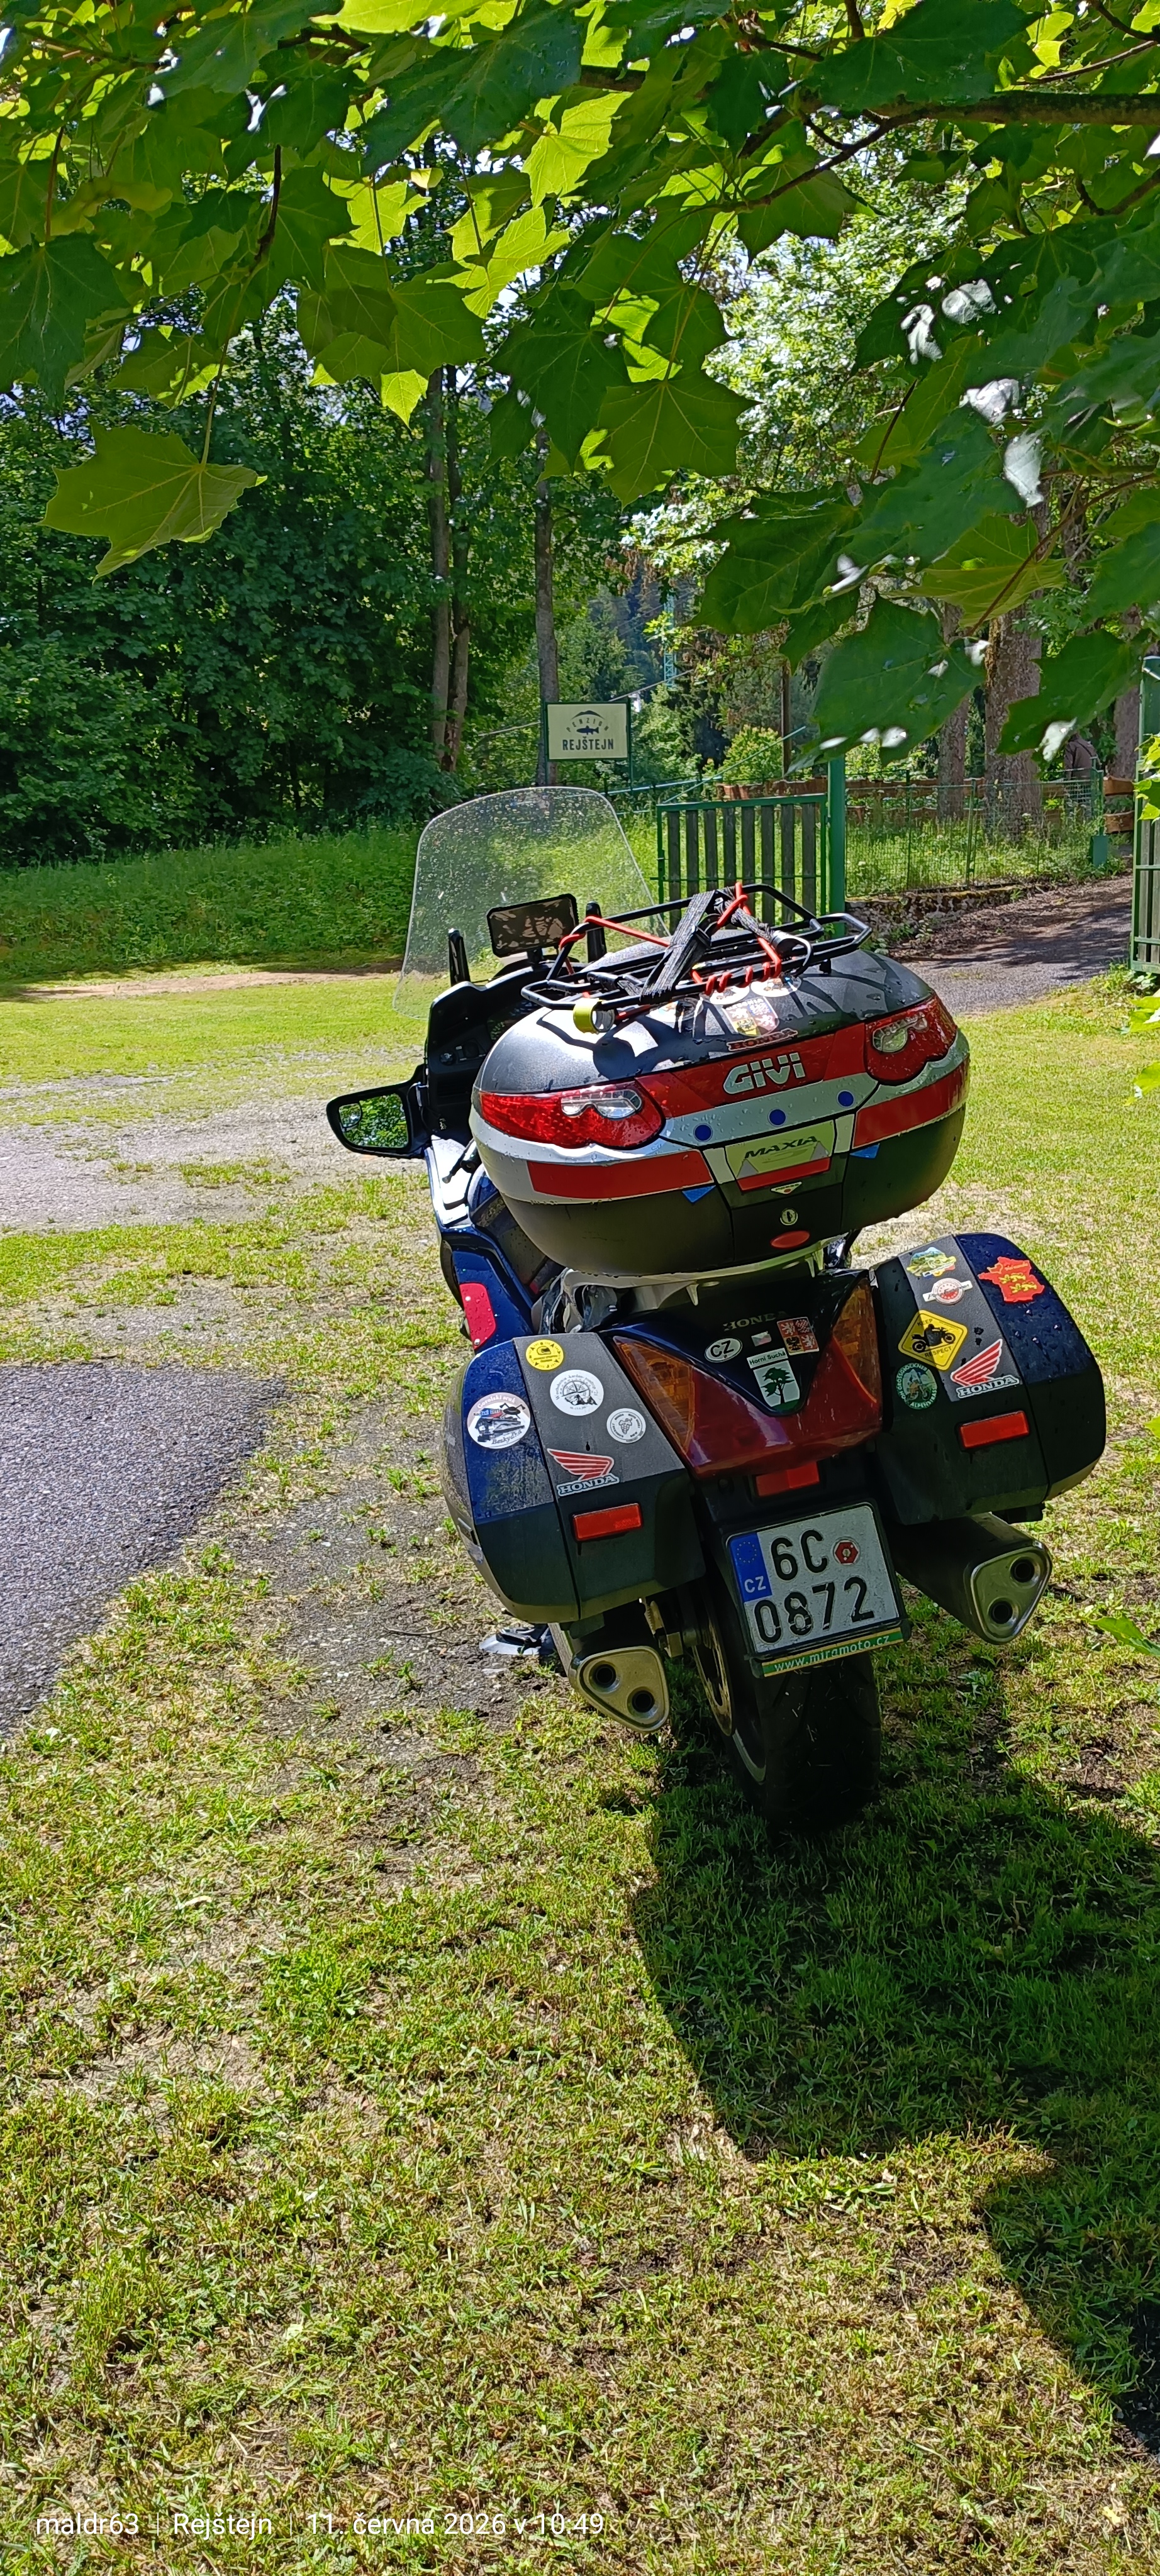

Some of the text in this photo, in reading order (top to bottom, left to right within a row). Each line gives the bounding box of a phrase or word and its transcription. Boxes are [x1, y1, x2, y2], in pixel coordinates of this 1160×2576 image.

[566, 718, 609, 733] PENZION
[562, 736, 614, 750] REJŠTEJN
[744, 1136, 818, 1159] MAXIA
[917, 1318, 933, 1327] KEEP
[710, 1340, 734, 1358] CZ
[925, 1346, 952, 1358] RESPECT
[749, 1356, 766, 1365] Horní
[959, 1377, 1016, 1396] HONDA
[559, 1475, 616, 1494] HONDA
[770, 1529, 828, 1581] 6C
[744, 1575, 766, 1593] CZ
[754, 1576, 875, 1643] 0872
[774, 1635, 890, 1672] www.miramoto.cz
